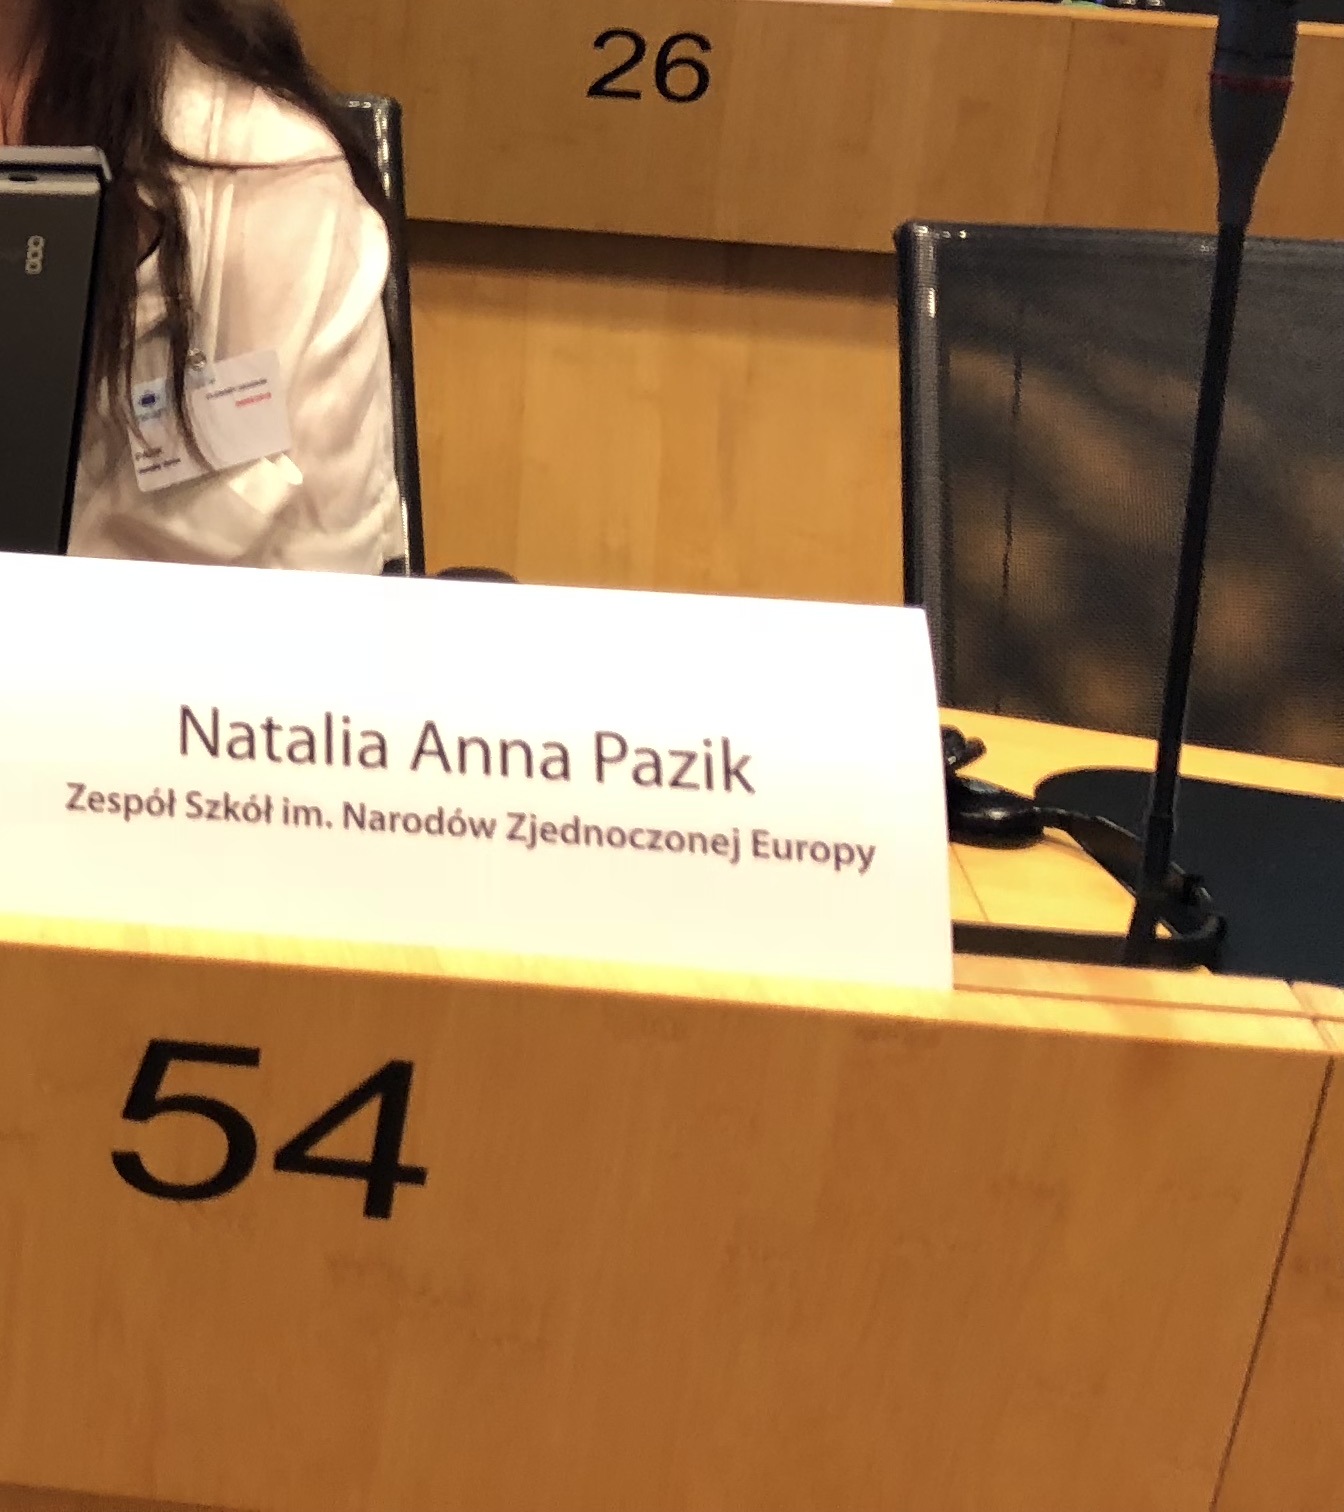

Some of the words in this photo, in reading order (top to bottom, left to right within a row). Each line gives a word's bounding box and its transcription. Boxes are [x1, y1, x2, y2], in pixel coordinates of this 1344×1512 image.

[587, 27, 713, 104] 26
[178, 703, 388, 770] Natalia
[408, 719, 571, 783] Anna
[594, 731, 756, 795] Pazik
[65, 781, 177, 823] Zespół
[185, 789, 275, 825] Szkół
[282, 796, 333, 830] im.
[342, 802, 497, 840] Narodów
[506, 813, 741, 865] Zjednoczonej
[751, 830, 876, 875] Europy
[111, 1037, 429, 1221] 54
